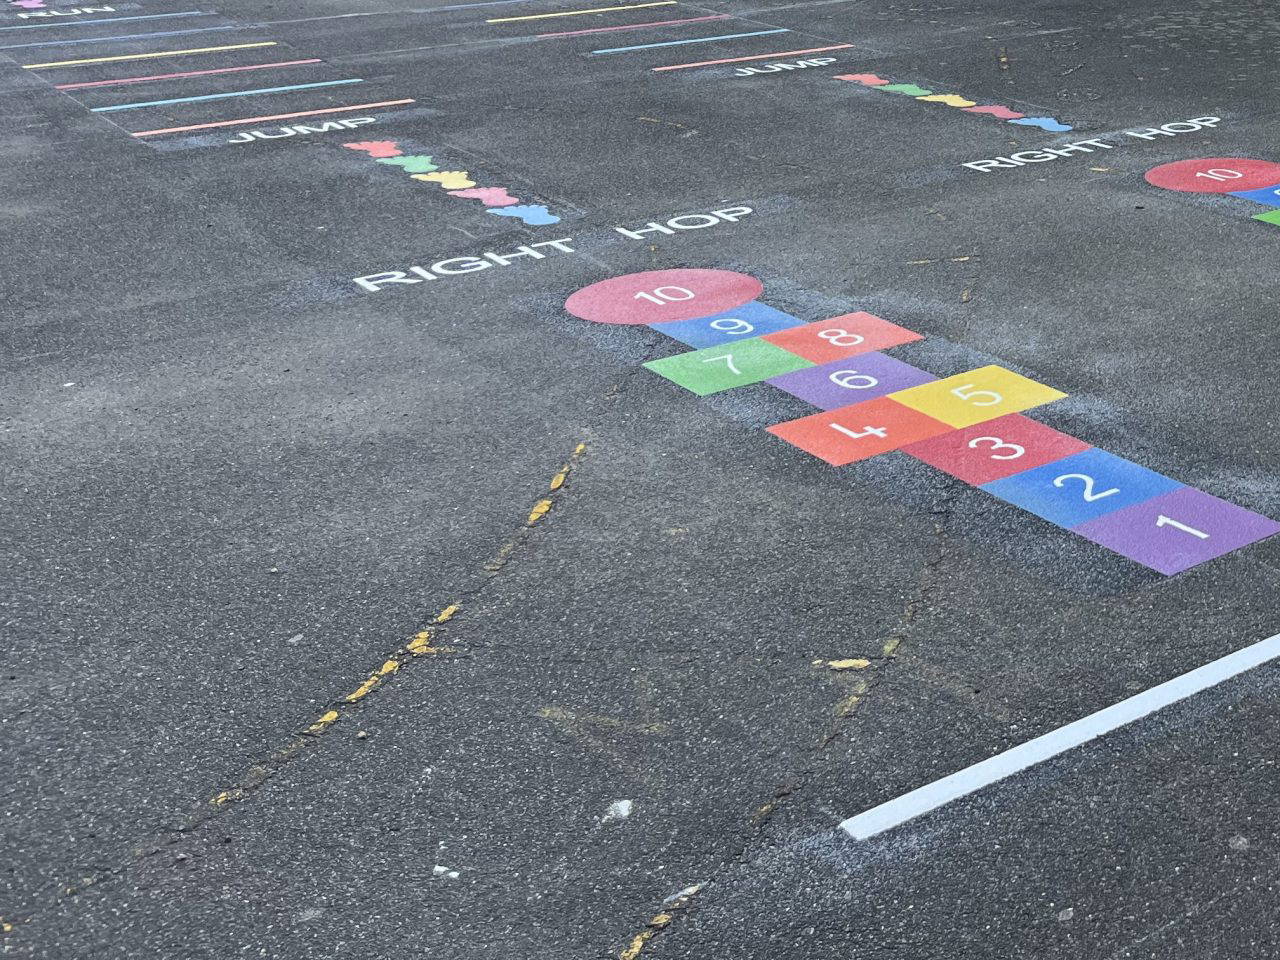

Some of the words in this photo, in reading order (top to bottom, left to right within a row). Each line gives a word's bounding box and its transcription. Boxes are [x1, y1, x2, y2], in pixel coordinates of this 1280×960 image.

[17, 5, 116, 19] RUN
[734, 57, 837, 77] JUMP
[228, 117, 376, 143] JUMP
[961, 138, 1113, 173] RIGHT
[1125, 116, 1221, 140] HOP
[1195, 168, 1243, 182] 10
[352, 237, 575, 292] RIGHT
[615, 206, 753, 240] HOP
[633, 285, 695, 306] 10
[710, 318, 754, 335] 9
[817, 328, 865, 347] 8
[702, 353, 741, 375] 7
[828, 369, 879, 389] 6
[950, 383, 1003, 407] 5
[829, 422, 887, 439] 4
[968, 436, 1025, 460] 3
[1053, 473, 1120, 502] 2
[1156, 514, 1210, 539] 1
